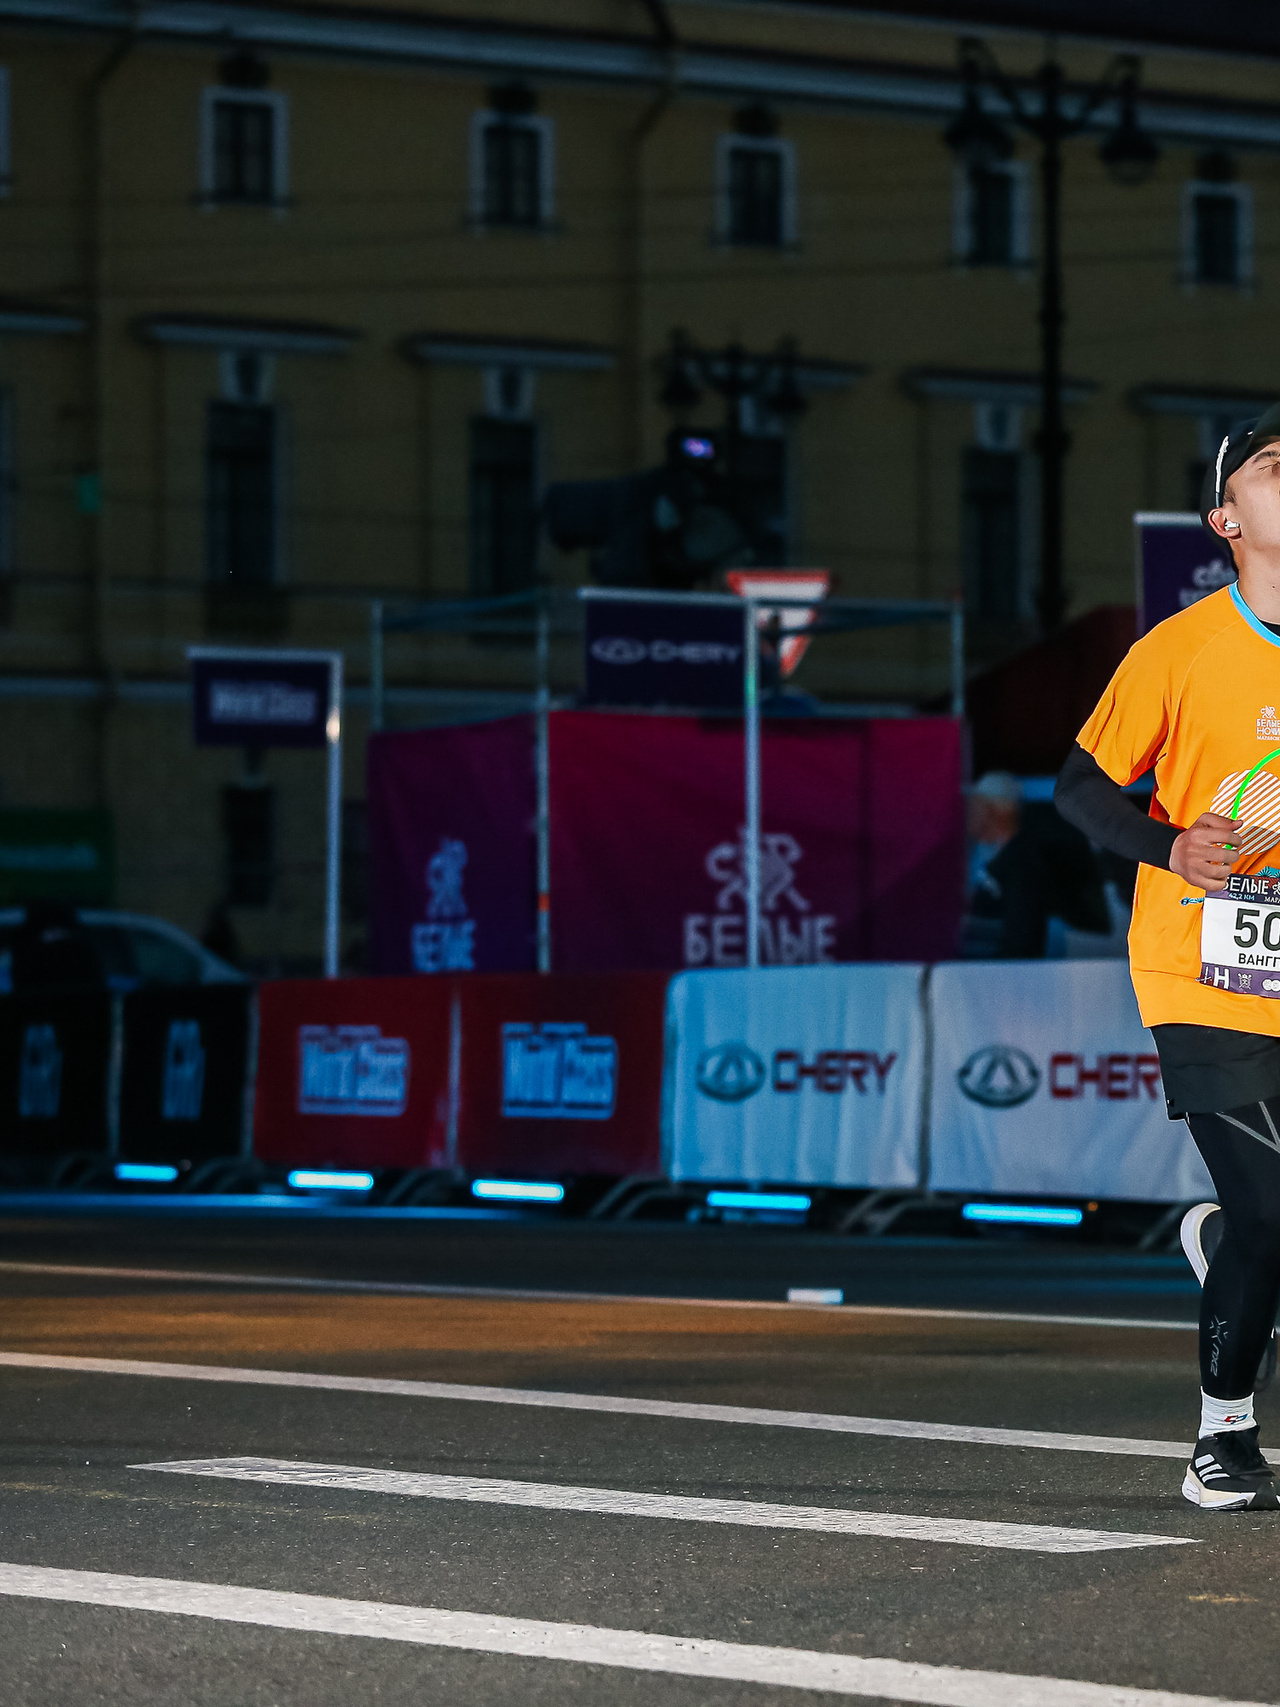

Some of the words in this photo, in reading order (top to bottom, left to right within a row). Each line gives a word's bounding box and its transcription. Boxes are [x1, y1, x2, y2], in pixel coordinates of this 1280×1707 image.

[1256, 718, 1280, 727] БЕЛЫЕ
[1256, 727, 1280, 736] НОЧИ
[773, 1049, 897, 1096] CHERY
[1050, 1053, 1160, 1099] CHER
